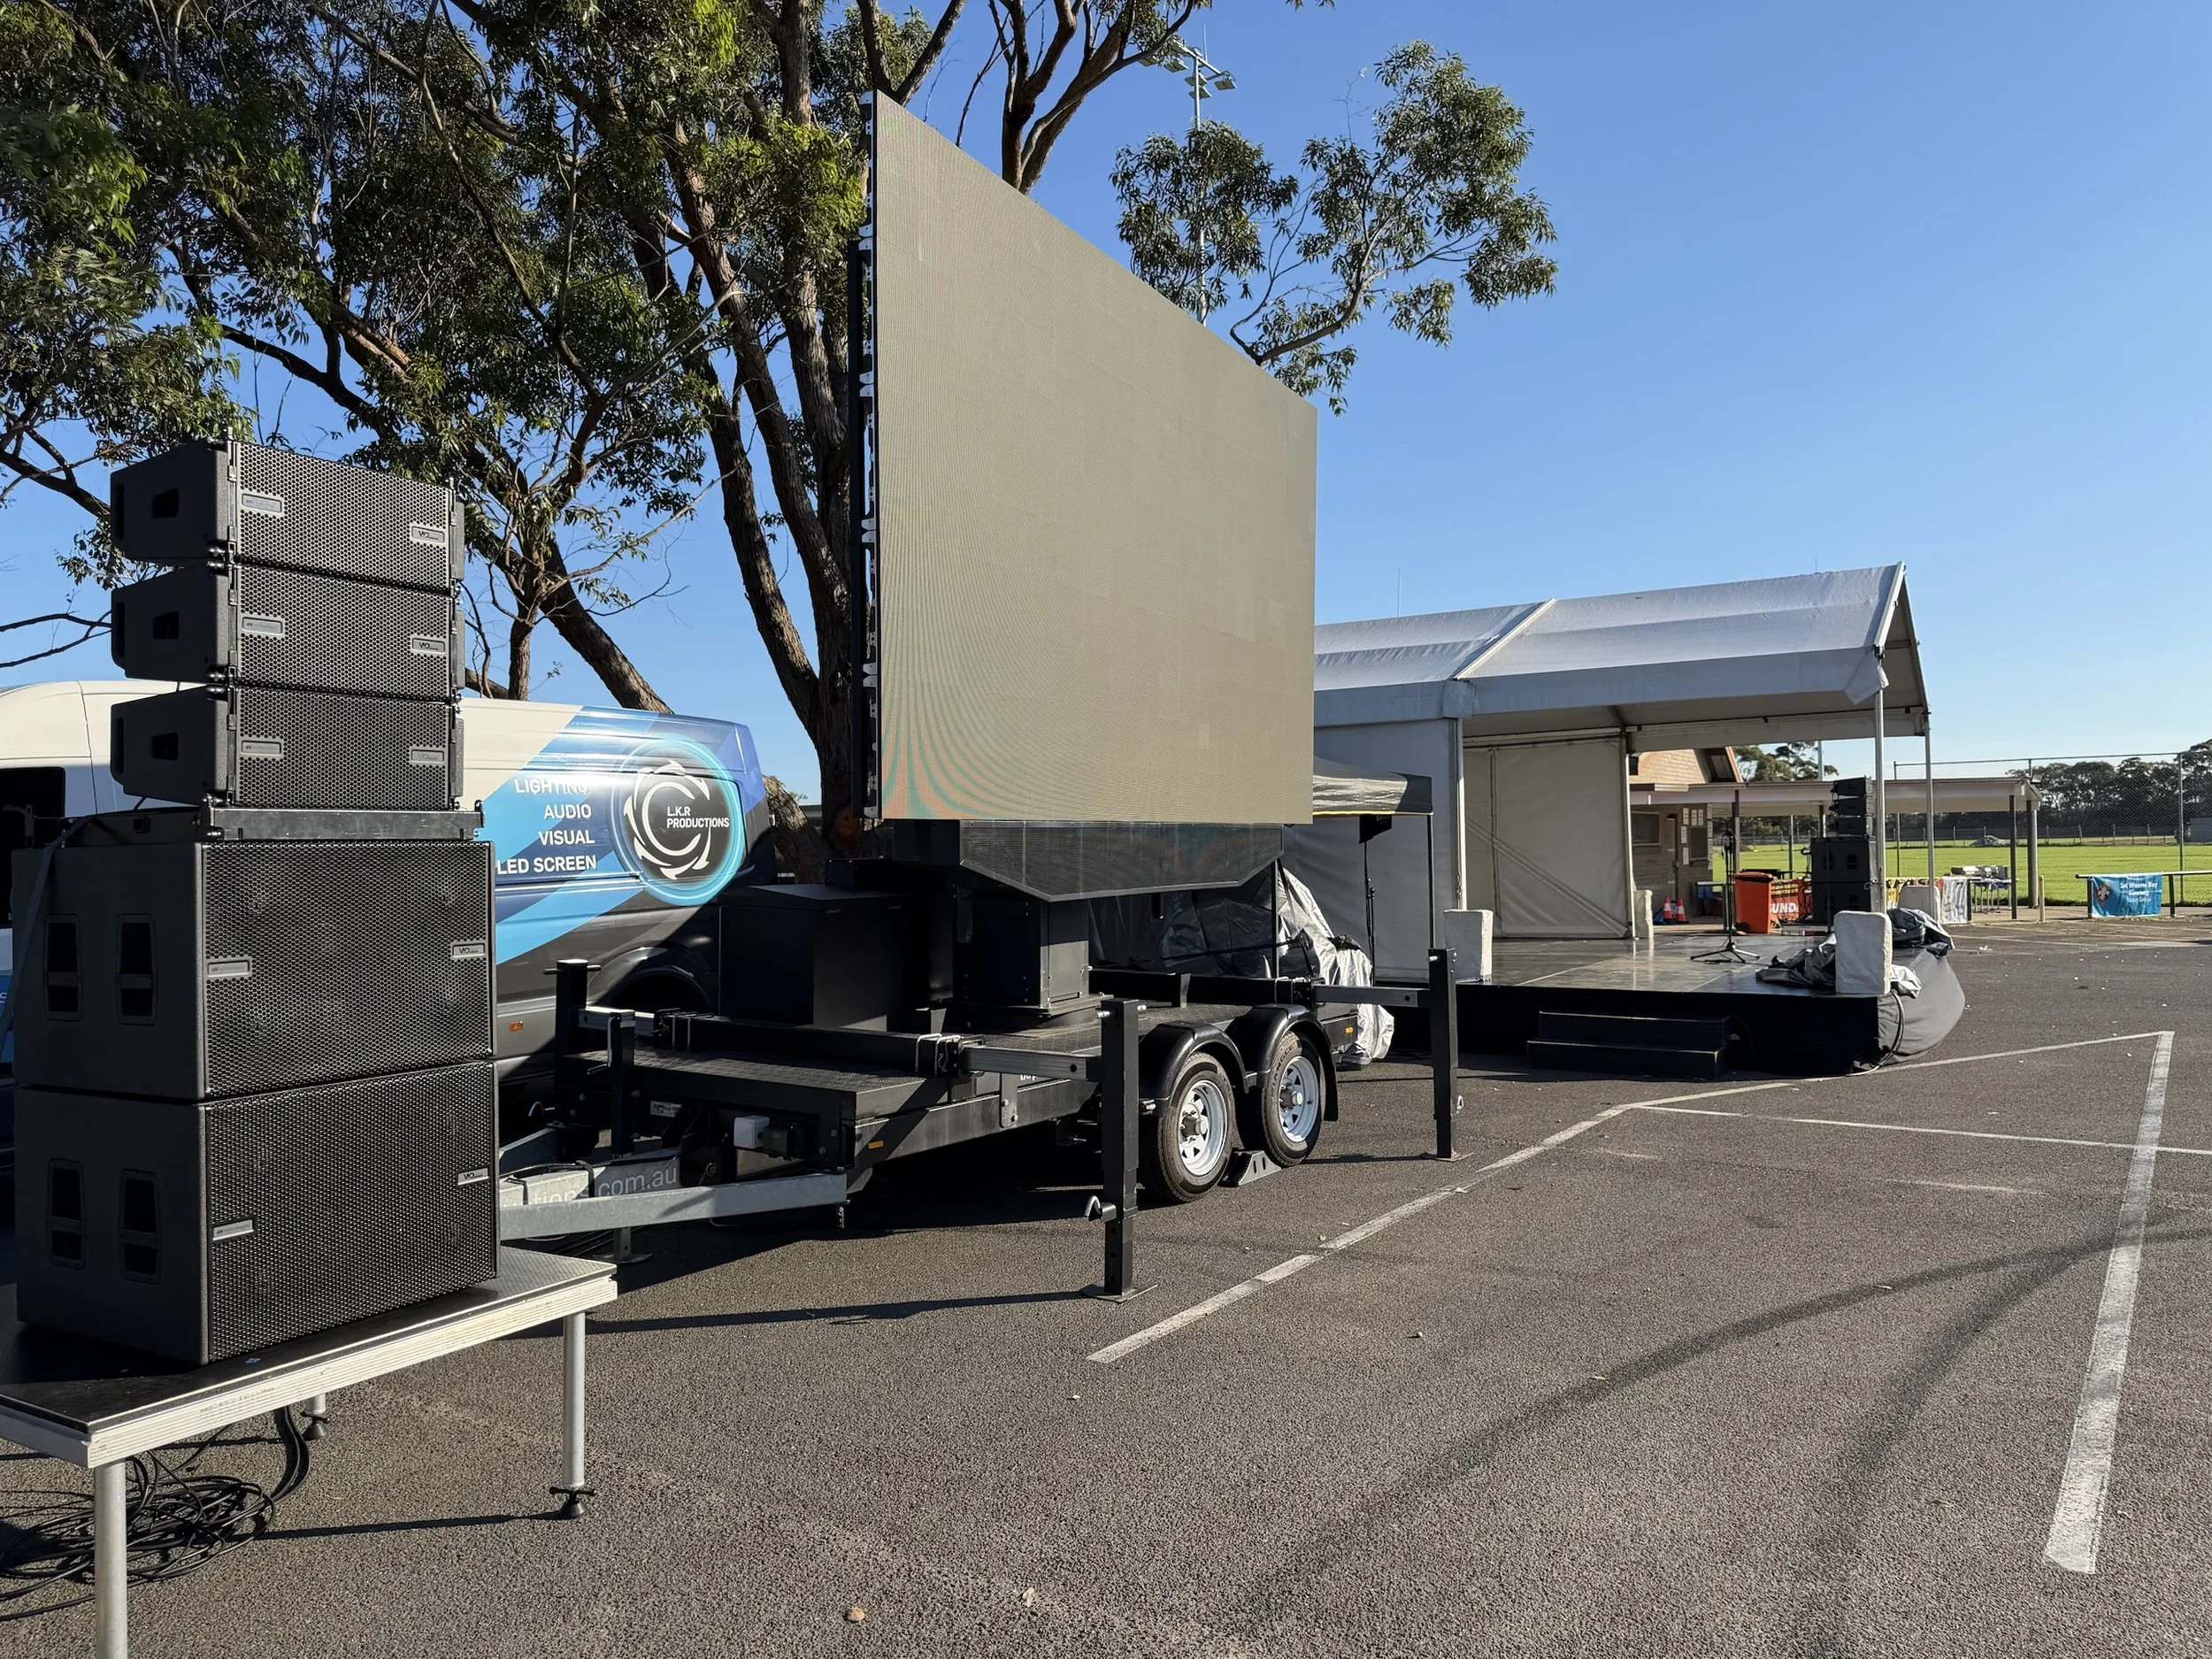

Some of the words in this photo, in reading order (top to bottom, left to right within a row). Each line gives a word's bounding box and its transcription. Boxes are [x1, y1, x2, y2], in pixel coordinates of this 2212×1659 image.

[514, 779, 589, 795] LIGHTING
[544, 803, 593, 819] AUDIO
[667, 806, 691, 817] L.K.R
[666, 817, 731, 829] PRODUCTIONS
[538, 829, 595, 846] VISUAL
[496, 857, 530, 875] LED
[534, 855, 597, 872] SCREEN
